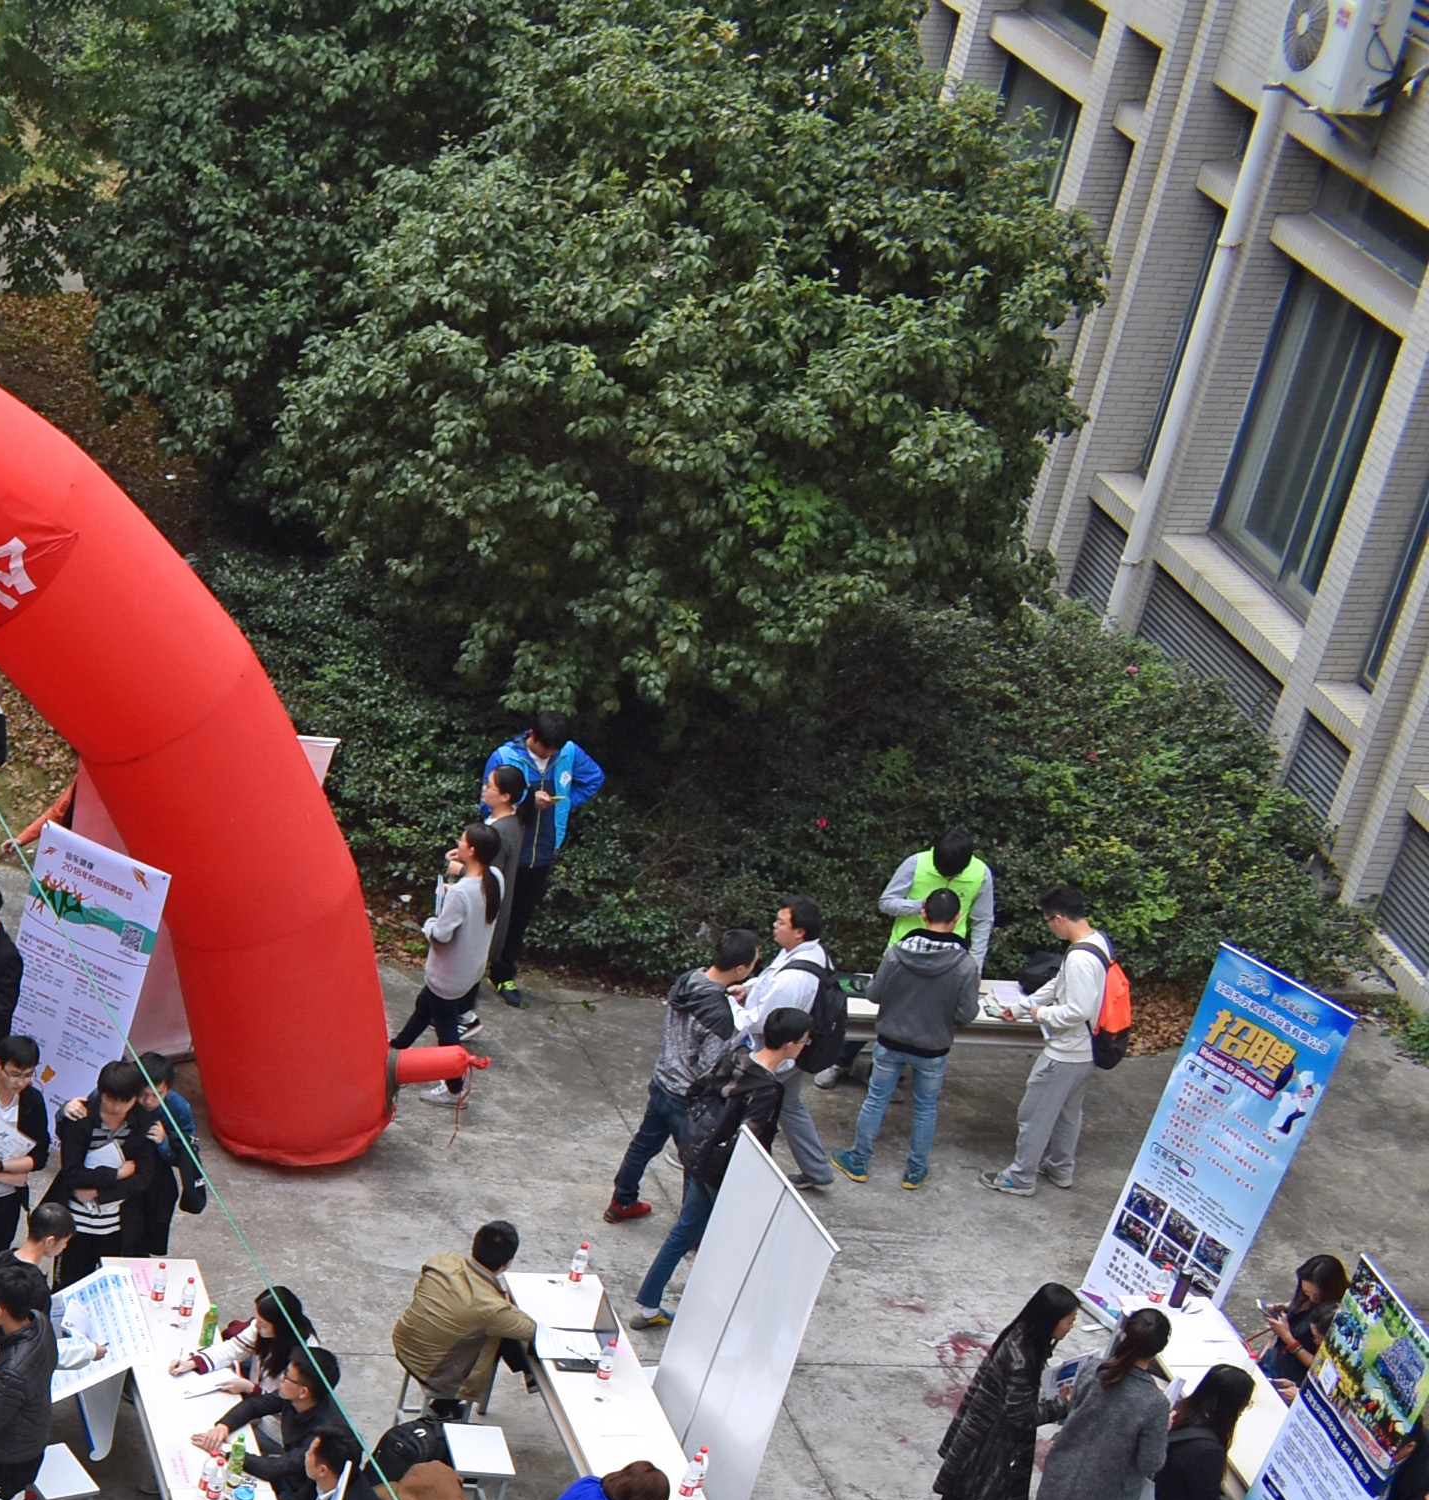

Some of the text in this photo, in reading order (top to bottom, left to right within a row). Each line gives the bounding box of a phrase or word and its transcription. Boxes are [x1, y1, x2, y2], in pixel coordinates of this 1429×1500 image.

[61, 861, 134, 901] 2018年校园招聘职位
[1203, 1008, 1297, 1081] 招聘
[1214, 980, 1330, 1053] 江阴市万和自动设备有限公司
[1197, 1047, 1226, 1069] Welcome
[1233, 1064, 1247, 1081] join
[1245, 1073, 1259, 1088] our
